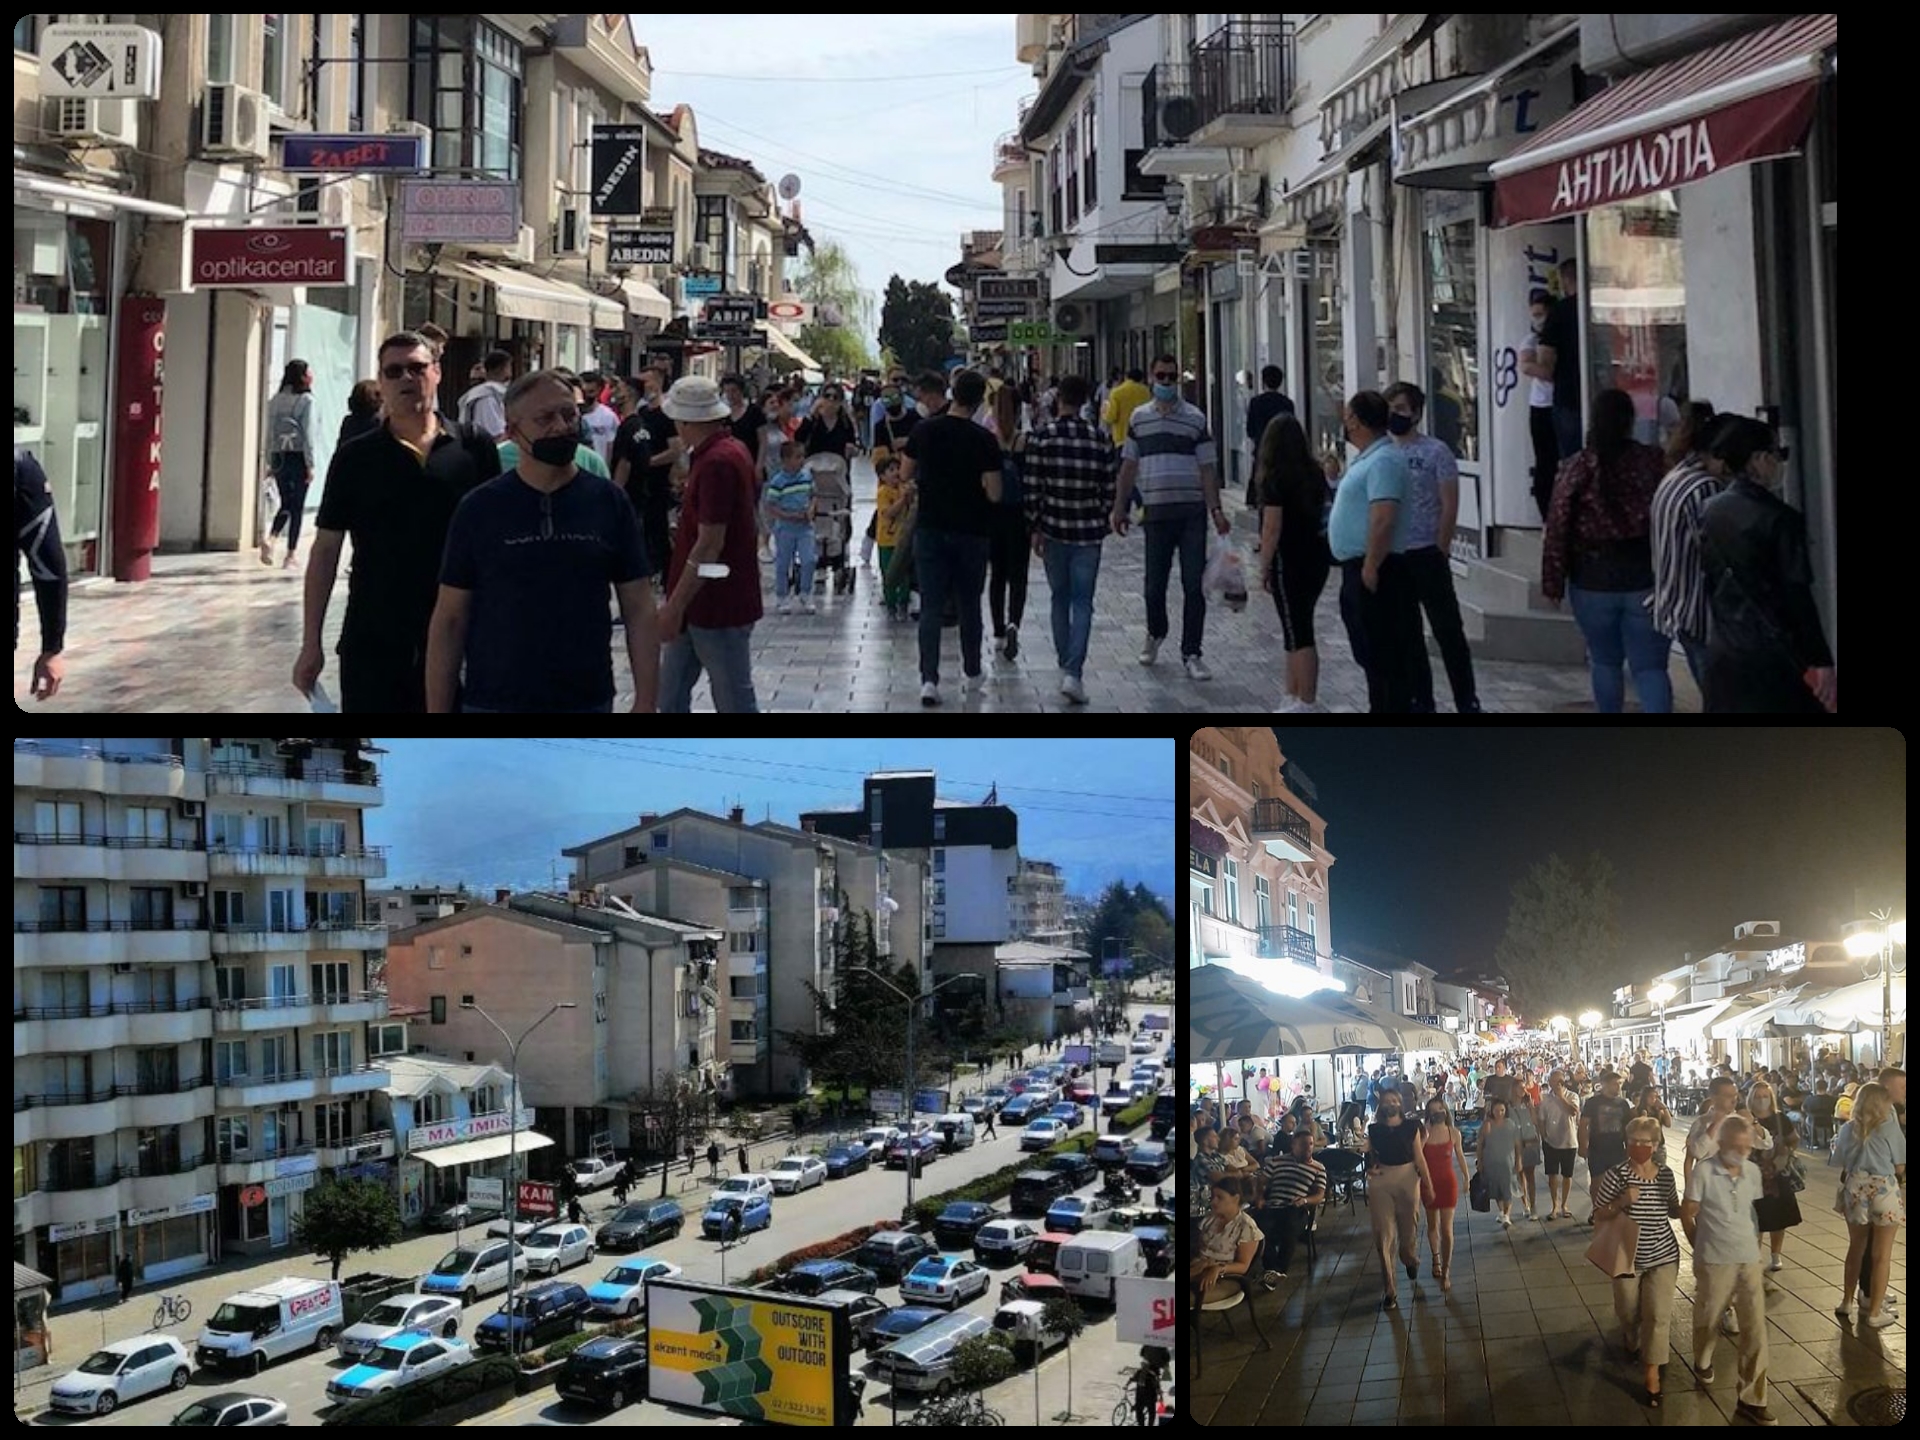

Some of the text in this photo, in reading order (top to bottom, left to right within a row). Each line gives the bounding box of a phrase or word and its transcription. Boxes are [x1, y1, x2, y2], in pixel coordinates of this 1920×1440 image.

[310, 141, 390, 168] ZABET
[1551, 119, 1717, 211] АНТИЛОПА
[595, 144, 639, 207] ABEDIN
[611, 248, 671, 262] ABEDIN
[200, 257, 337, 281] optikacentar
[148, 331, 166, 491] OPTIKA
[520, 1185, 554, 1203] KAM
[771, 1310, 826, 1333] OUTSCORE
[654, 1341, 722, 1363] akzent media
[798, 1331, 826, 1350] WITH
[777, 1345, 826, 1368] OUTDOOR
